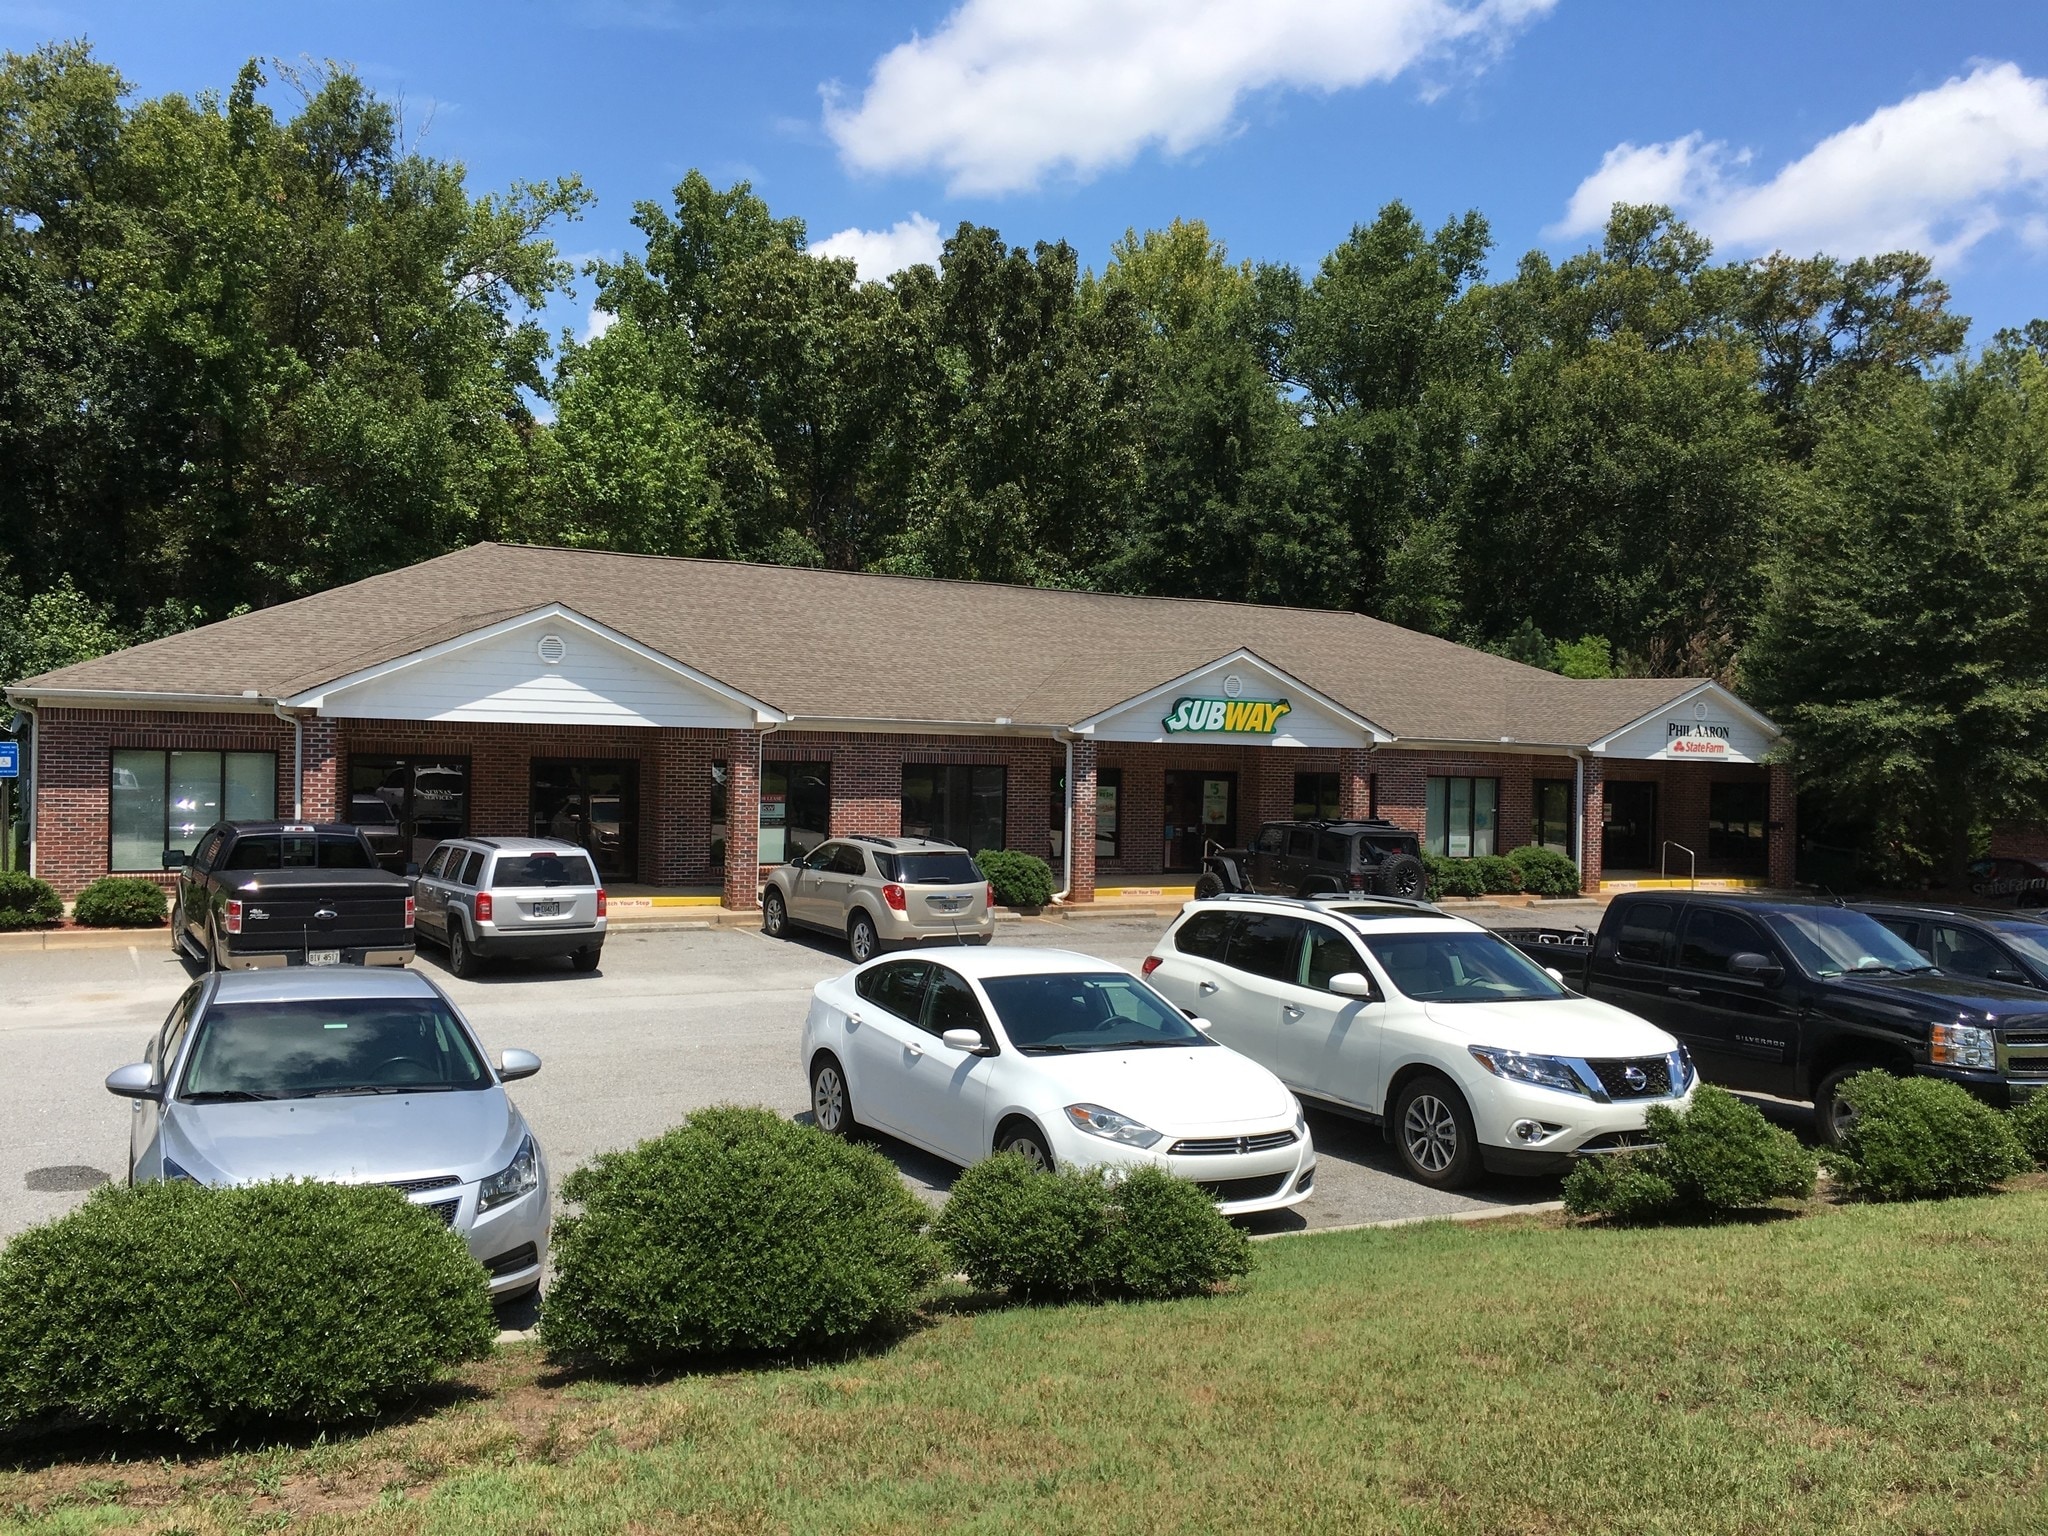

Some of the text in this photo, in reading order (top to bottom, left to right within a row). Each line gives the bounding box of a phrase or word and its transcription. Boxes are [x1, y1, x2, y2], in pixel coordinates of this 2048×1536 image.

[1167, 700, 1290, 732] SUBWAY
[1669, 723, 1729, 738] PHIL AARON
[1735, 1035, 1785, 1047] SILVERADO
